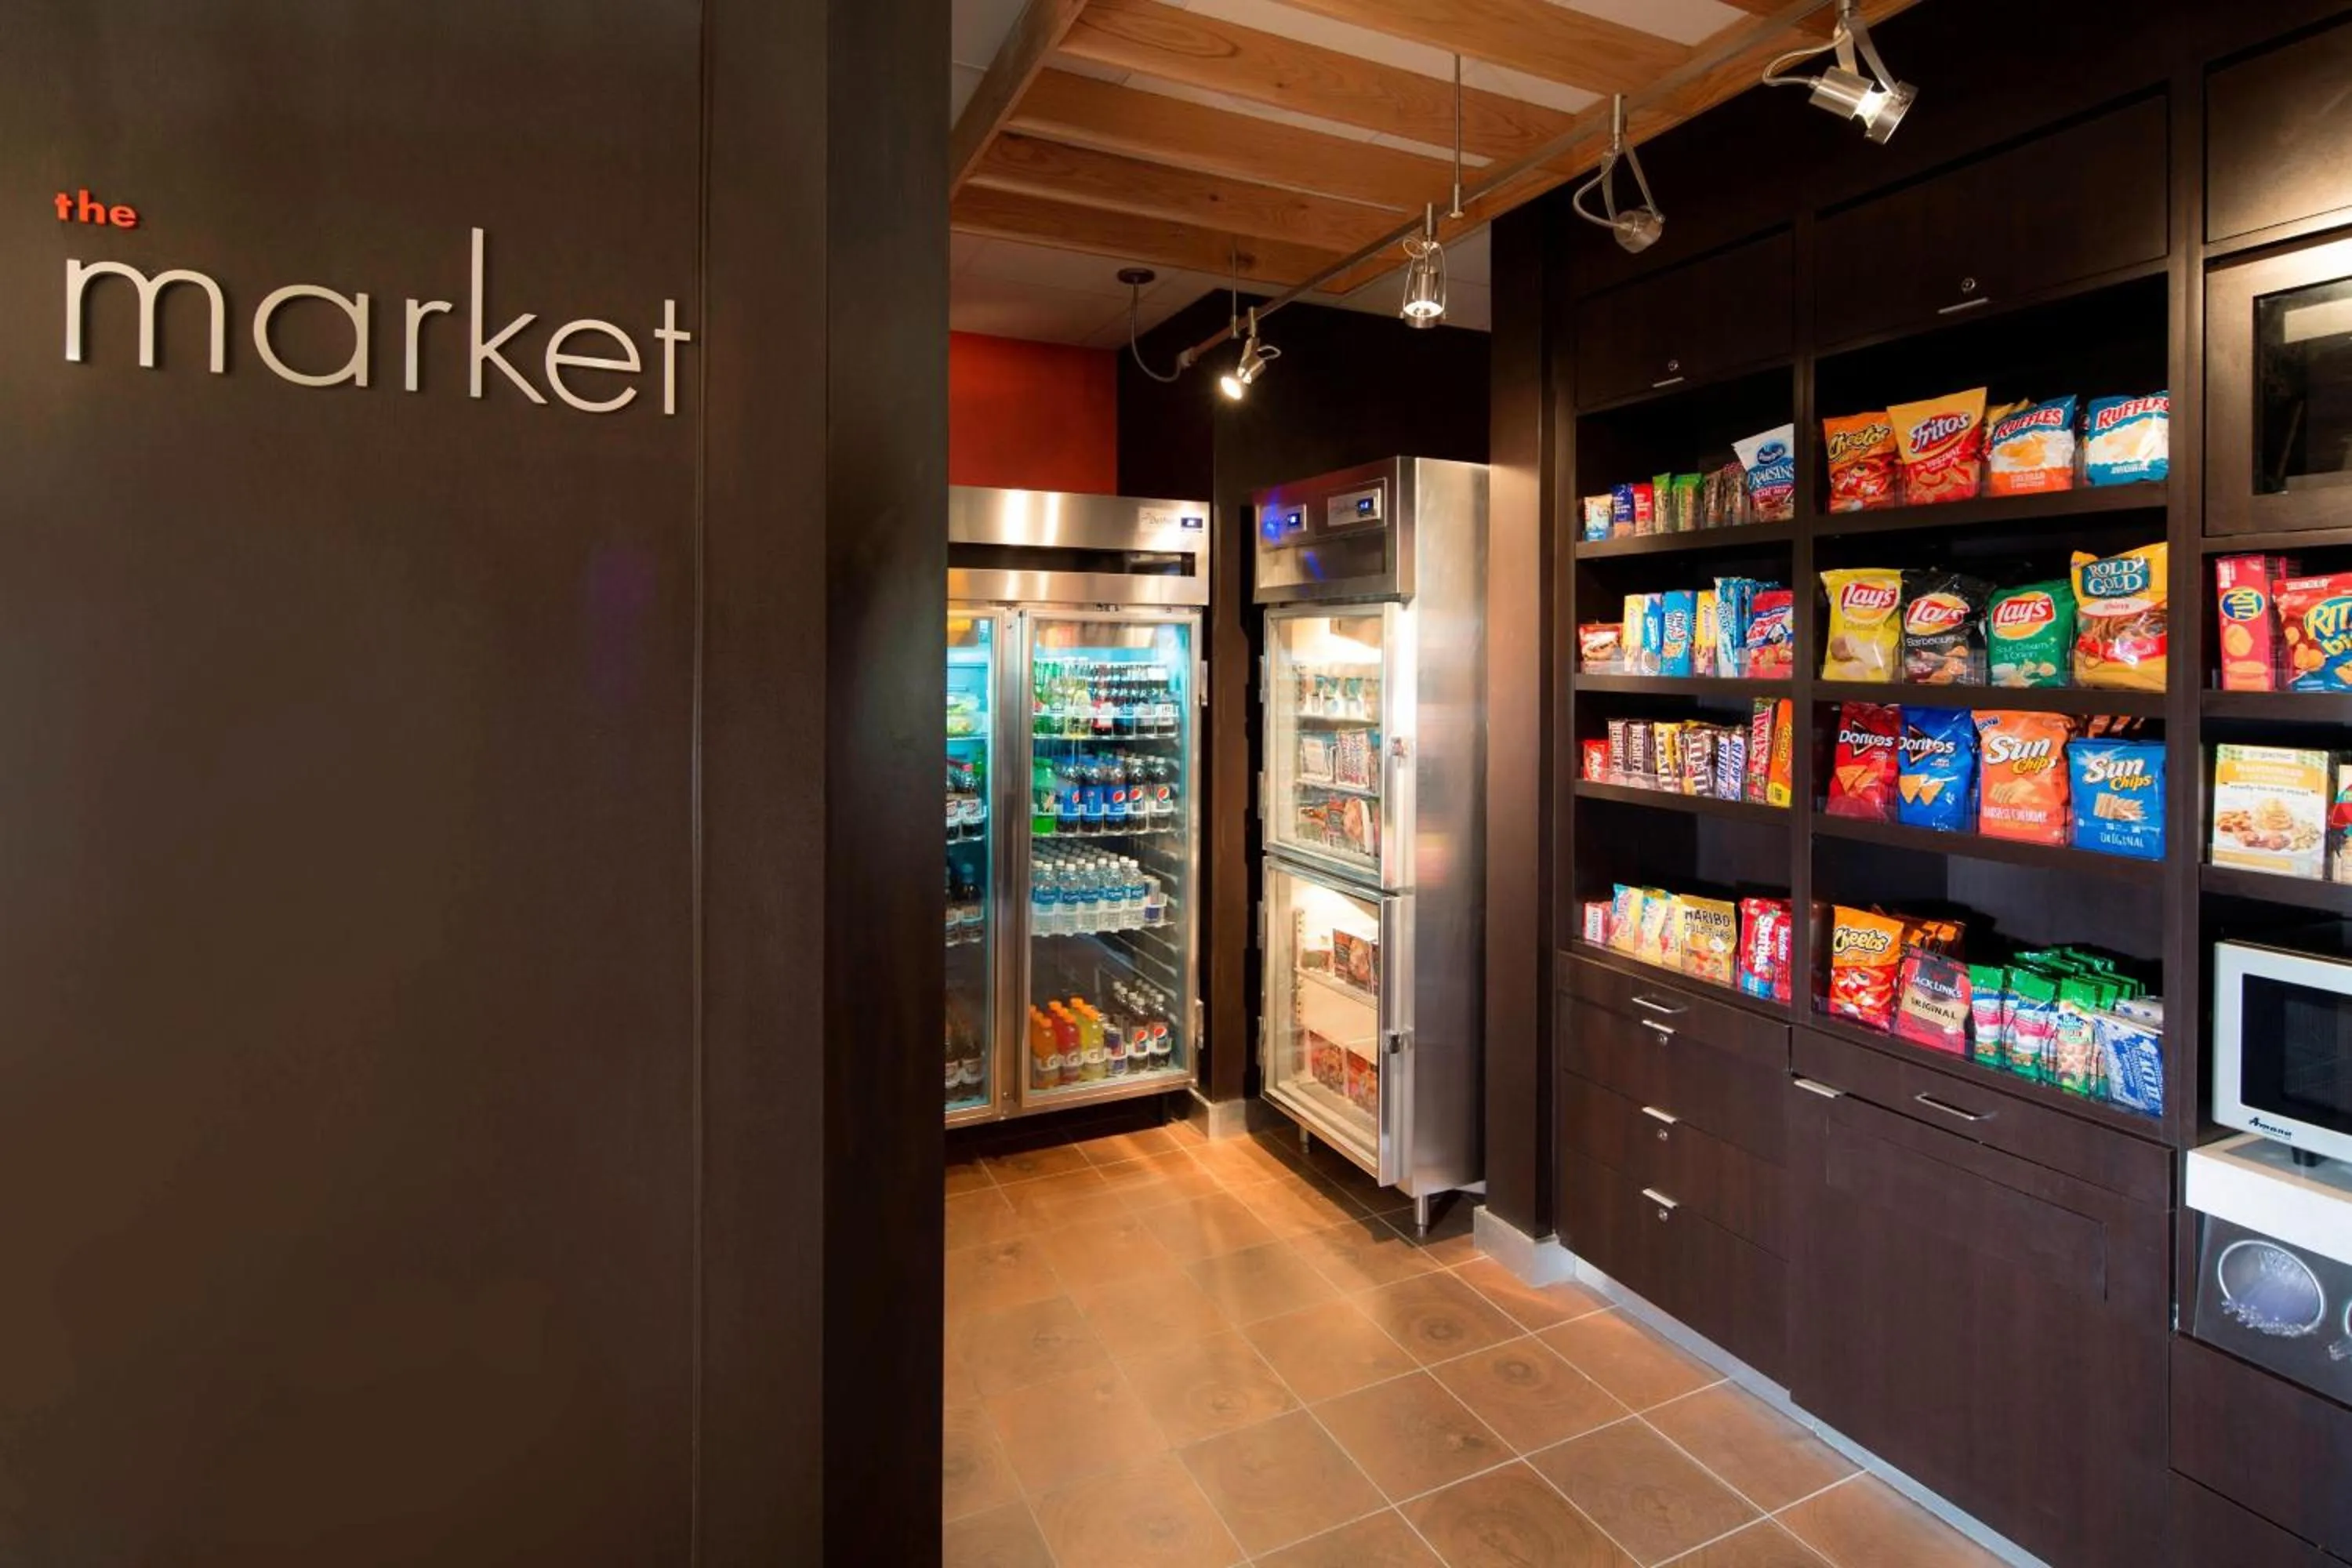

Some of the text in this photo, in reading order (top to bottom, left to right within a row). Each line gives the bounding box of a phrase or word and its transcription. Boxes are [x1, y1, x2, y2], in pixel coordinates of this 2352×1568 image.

[55, 190, 137, 228] the
[65, 227, 691, 415] market
[1996, 408, 2063, 438] RUFFLES
[2096, 397, 2169, 429] RUFFLES
[1908, 413, 1970, 453] Fritos
[2087, 560, 2137, 579] ROLD
[2088, 573, 2143, 595] GOLD
[2306, 603, 2352, 641] RIT
[1838, 729, 1895, 748] Doritos
[1898, 735, 1956, 754] Doritos
[1986, 735, 2051, 764] Sun
[2012, 757, 2058, 775] Chips
[2083, 757, 2144, 784] Sun
[2110, 775, 2152, 791] Chips
[2100, 832, 2144, 848] ORIGINAL
[1684, 909, 1730, 927] HARIBO
[1833, 927, 1889, 954] Cheetos
